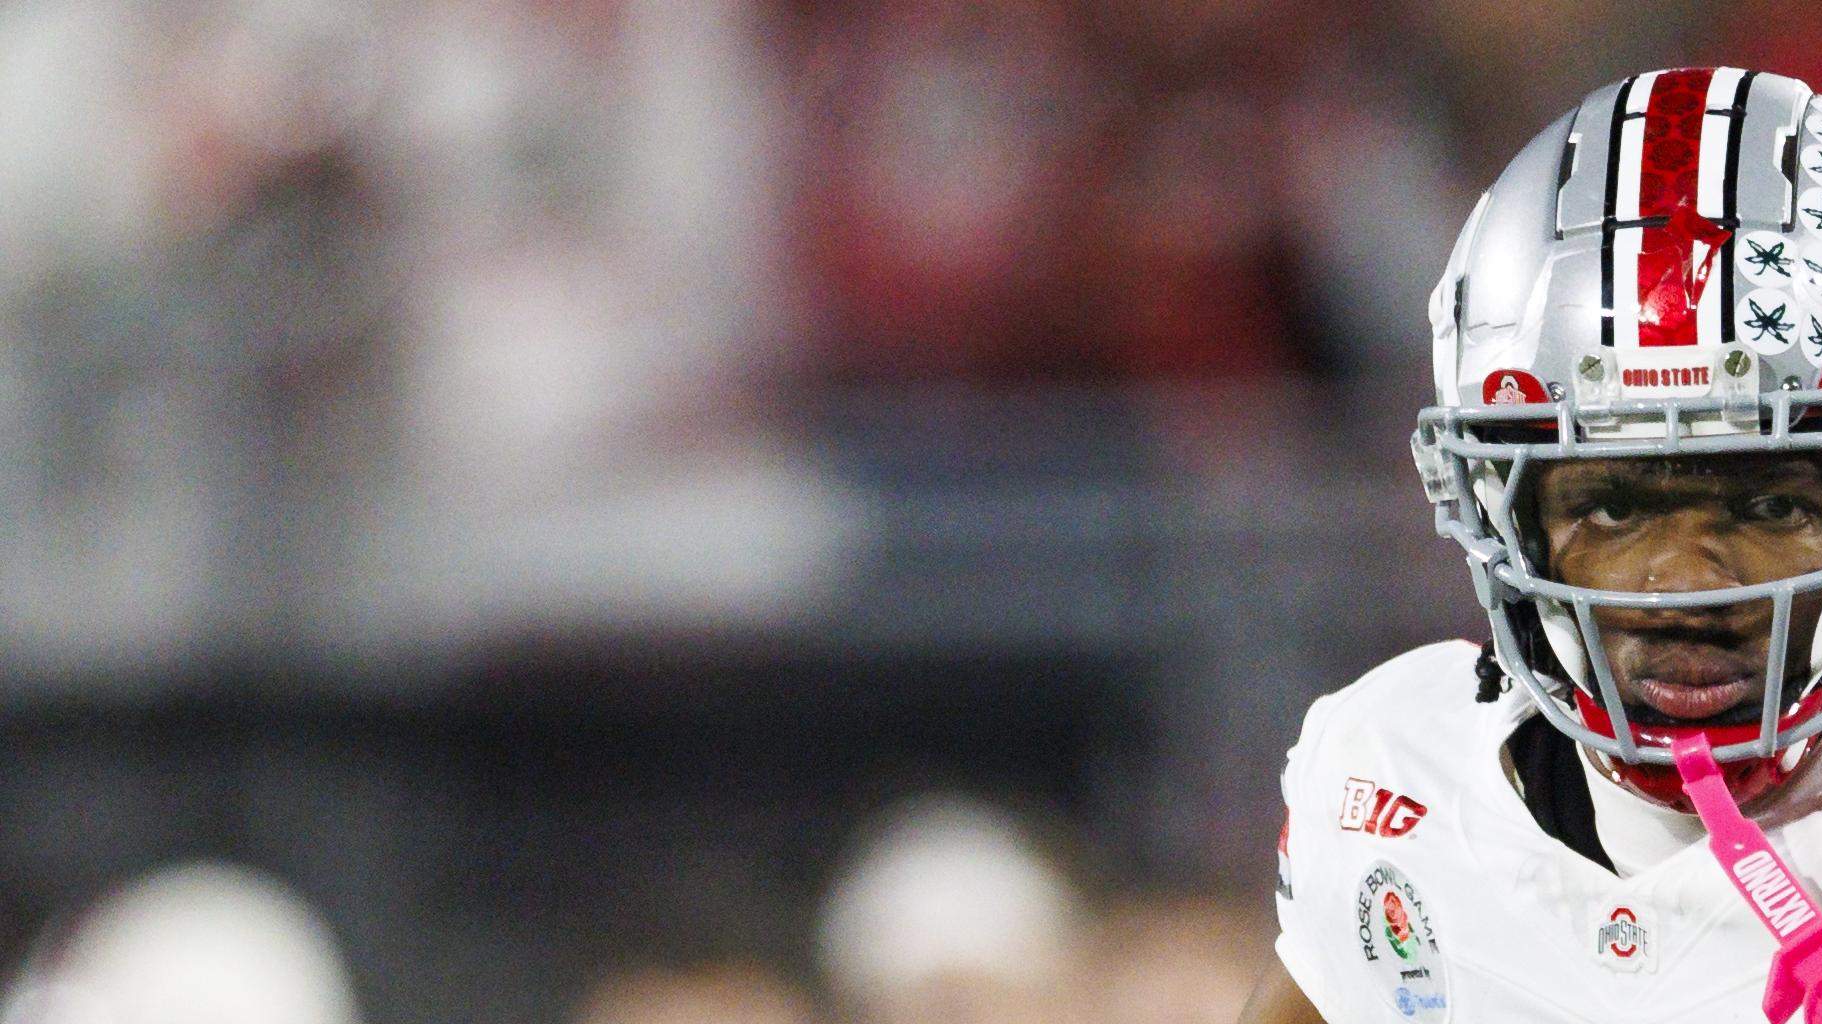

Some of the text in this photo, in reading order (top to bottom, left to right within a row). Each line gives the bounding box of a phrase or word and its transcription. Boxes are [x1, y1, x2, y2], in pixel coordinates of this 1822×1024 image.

[1622, 366, 1709, 387] OHIO STATE
[1358, 866, 1440, 962] ROSE BOWL GAME
[1732, 850, 1817, 938] NXTRND
[1598, 919, 1648, 956] OHIO STATE
